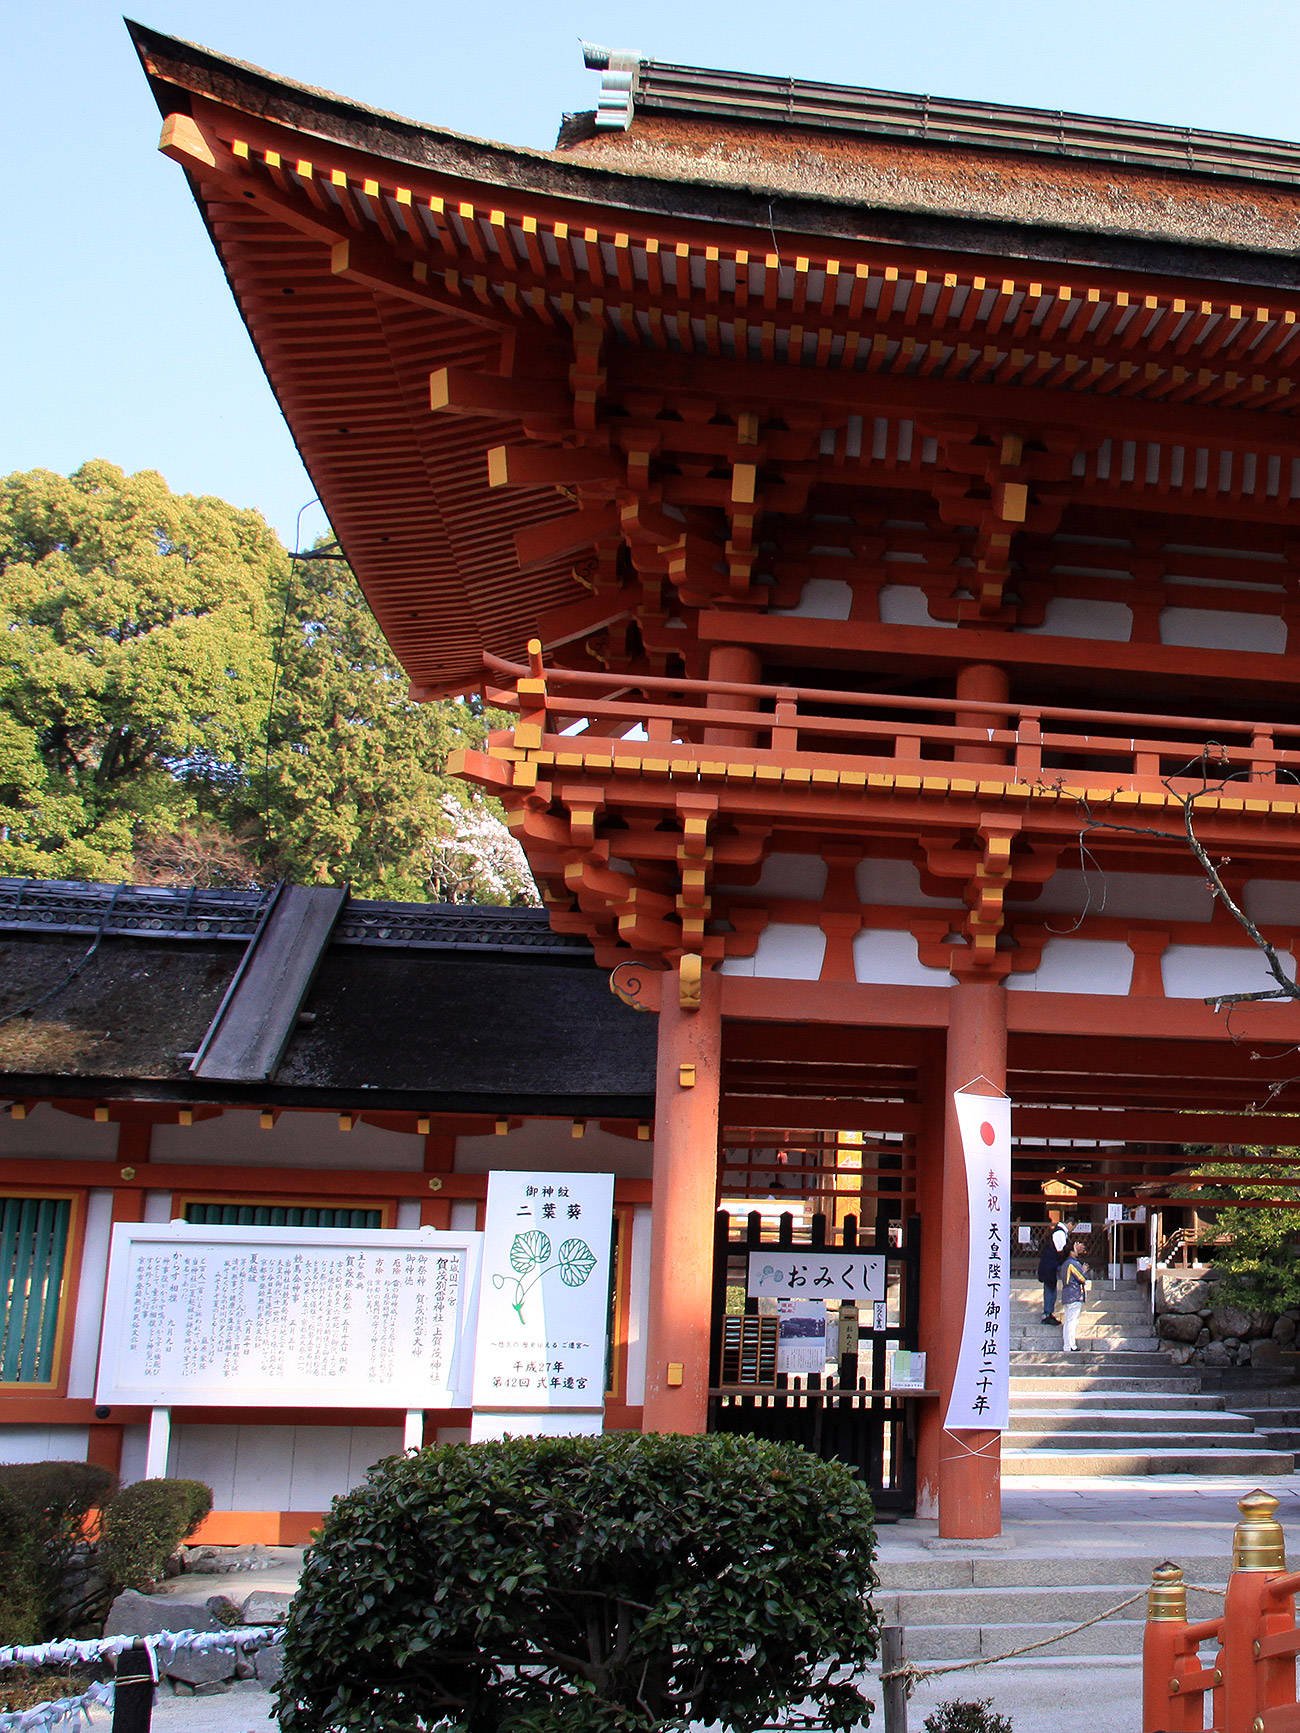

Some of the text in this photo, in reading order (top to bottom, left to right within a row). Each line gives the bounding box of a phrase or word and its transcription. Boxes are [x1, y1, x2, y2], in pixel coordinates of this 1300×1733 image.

[525, 1185, 570, 1198] 御神紋
[516, 1203, 582, 1220] 二葉葵
[354, 1251, 367, 1290] 主な祭典
[374, 1258, 385, 1275] 方除
[787, 1262, 878, 1292] おみくじ
[971, 1169, 1002, 1416] 奉祝 天皇陛下御即位二十年
[411, 1254, 429, 1359] 御祭神 賀茂別雷大神
[513, 1361, 564, 1373] 平成27年
[492, 1376, 588, 1390] 第42回 式年遷宮
